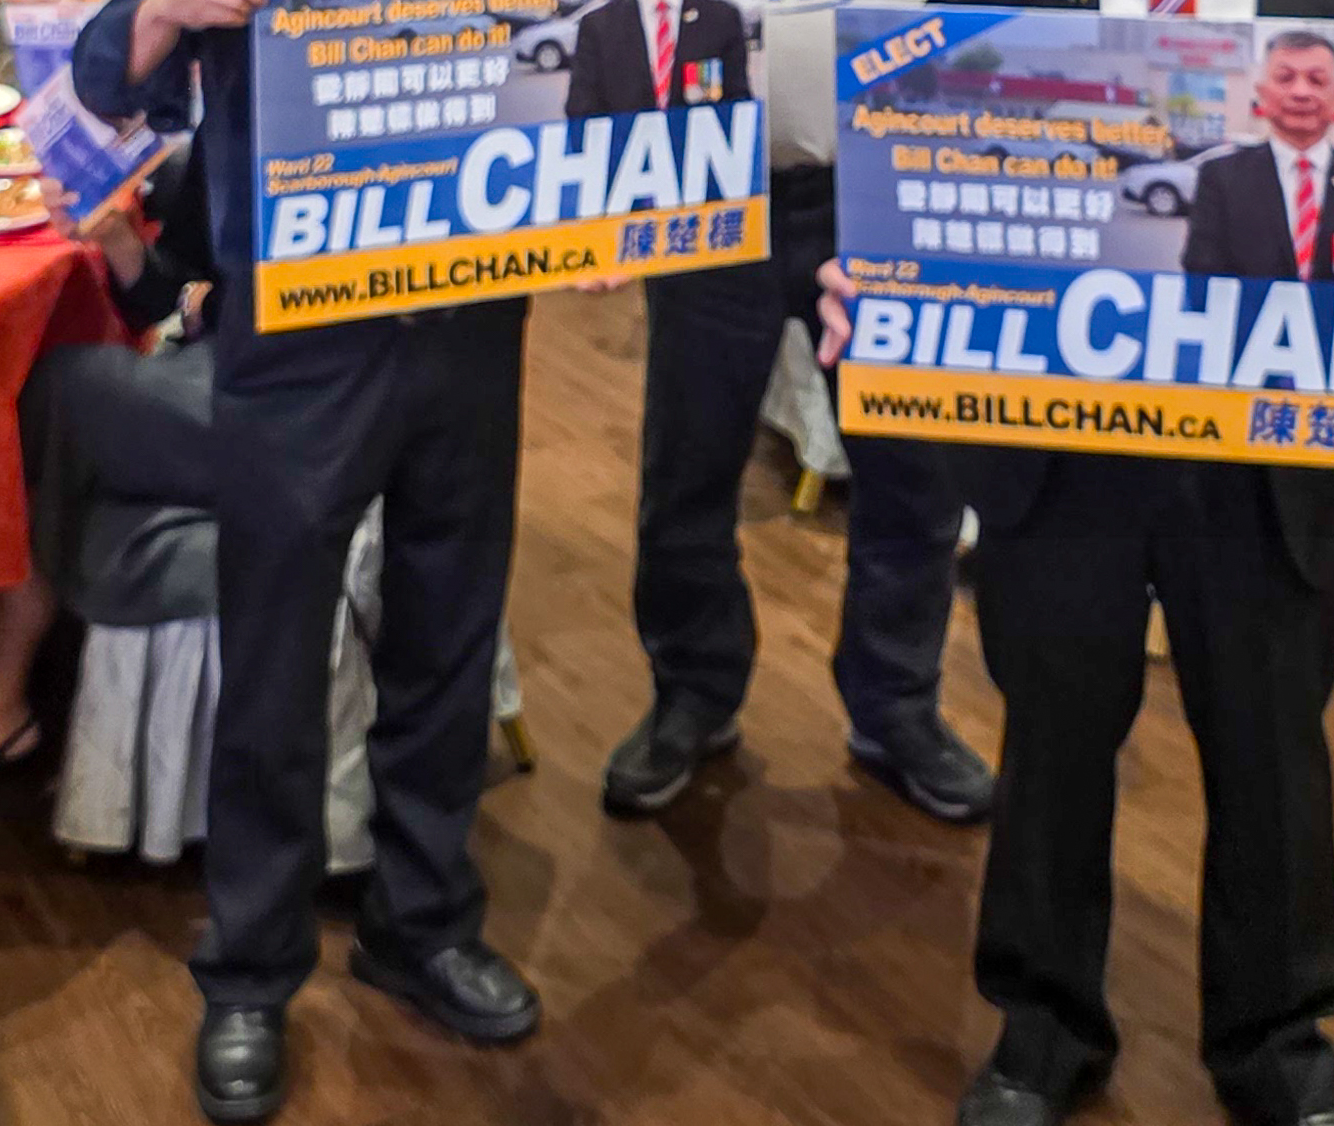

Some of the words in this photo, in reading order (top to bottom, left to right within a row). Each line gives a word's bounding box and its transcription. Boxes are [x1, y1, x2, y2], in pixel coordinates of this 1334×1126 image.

[271, 0, 382, 39] Agincourt
[307, 39, 346, 68] Bill
[349, 35, 408, 63] Chan
[410, 33, 453, 57] can
[456, 27, 485, 52] do
[487, 23, 511, 47] it!
[851, 16, 946, 85] ELECT
[852, 103, 970, 139] Agincourt
[975, 111, 1087, 143] deserves
[268, 157, 310, 178] Ward
[271, 180, 449, 261] BILL
[457, 100, 757, 234] CHAN
[892, 144, 932, 172] Bill
[935, 146, 999, 175] Chan
[1003, 155, 1051, 179] can
[1053, 153, 1087, 180] do
[1091, 155, 1118, 181] it!
[850, 298, 1049, 373] BILL
